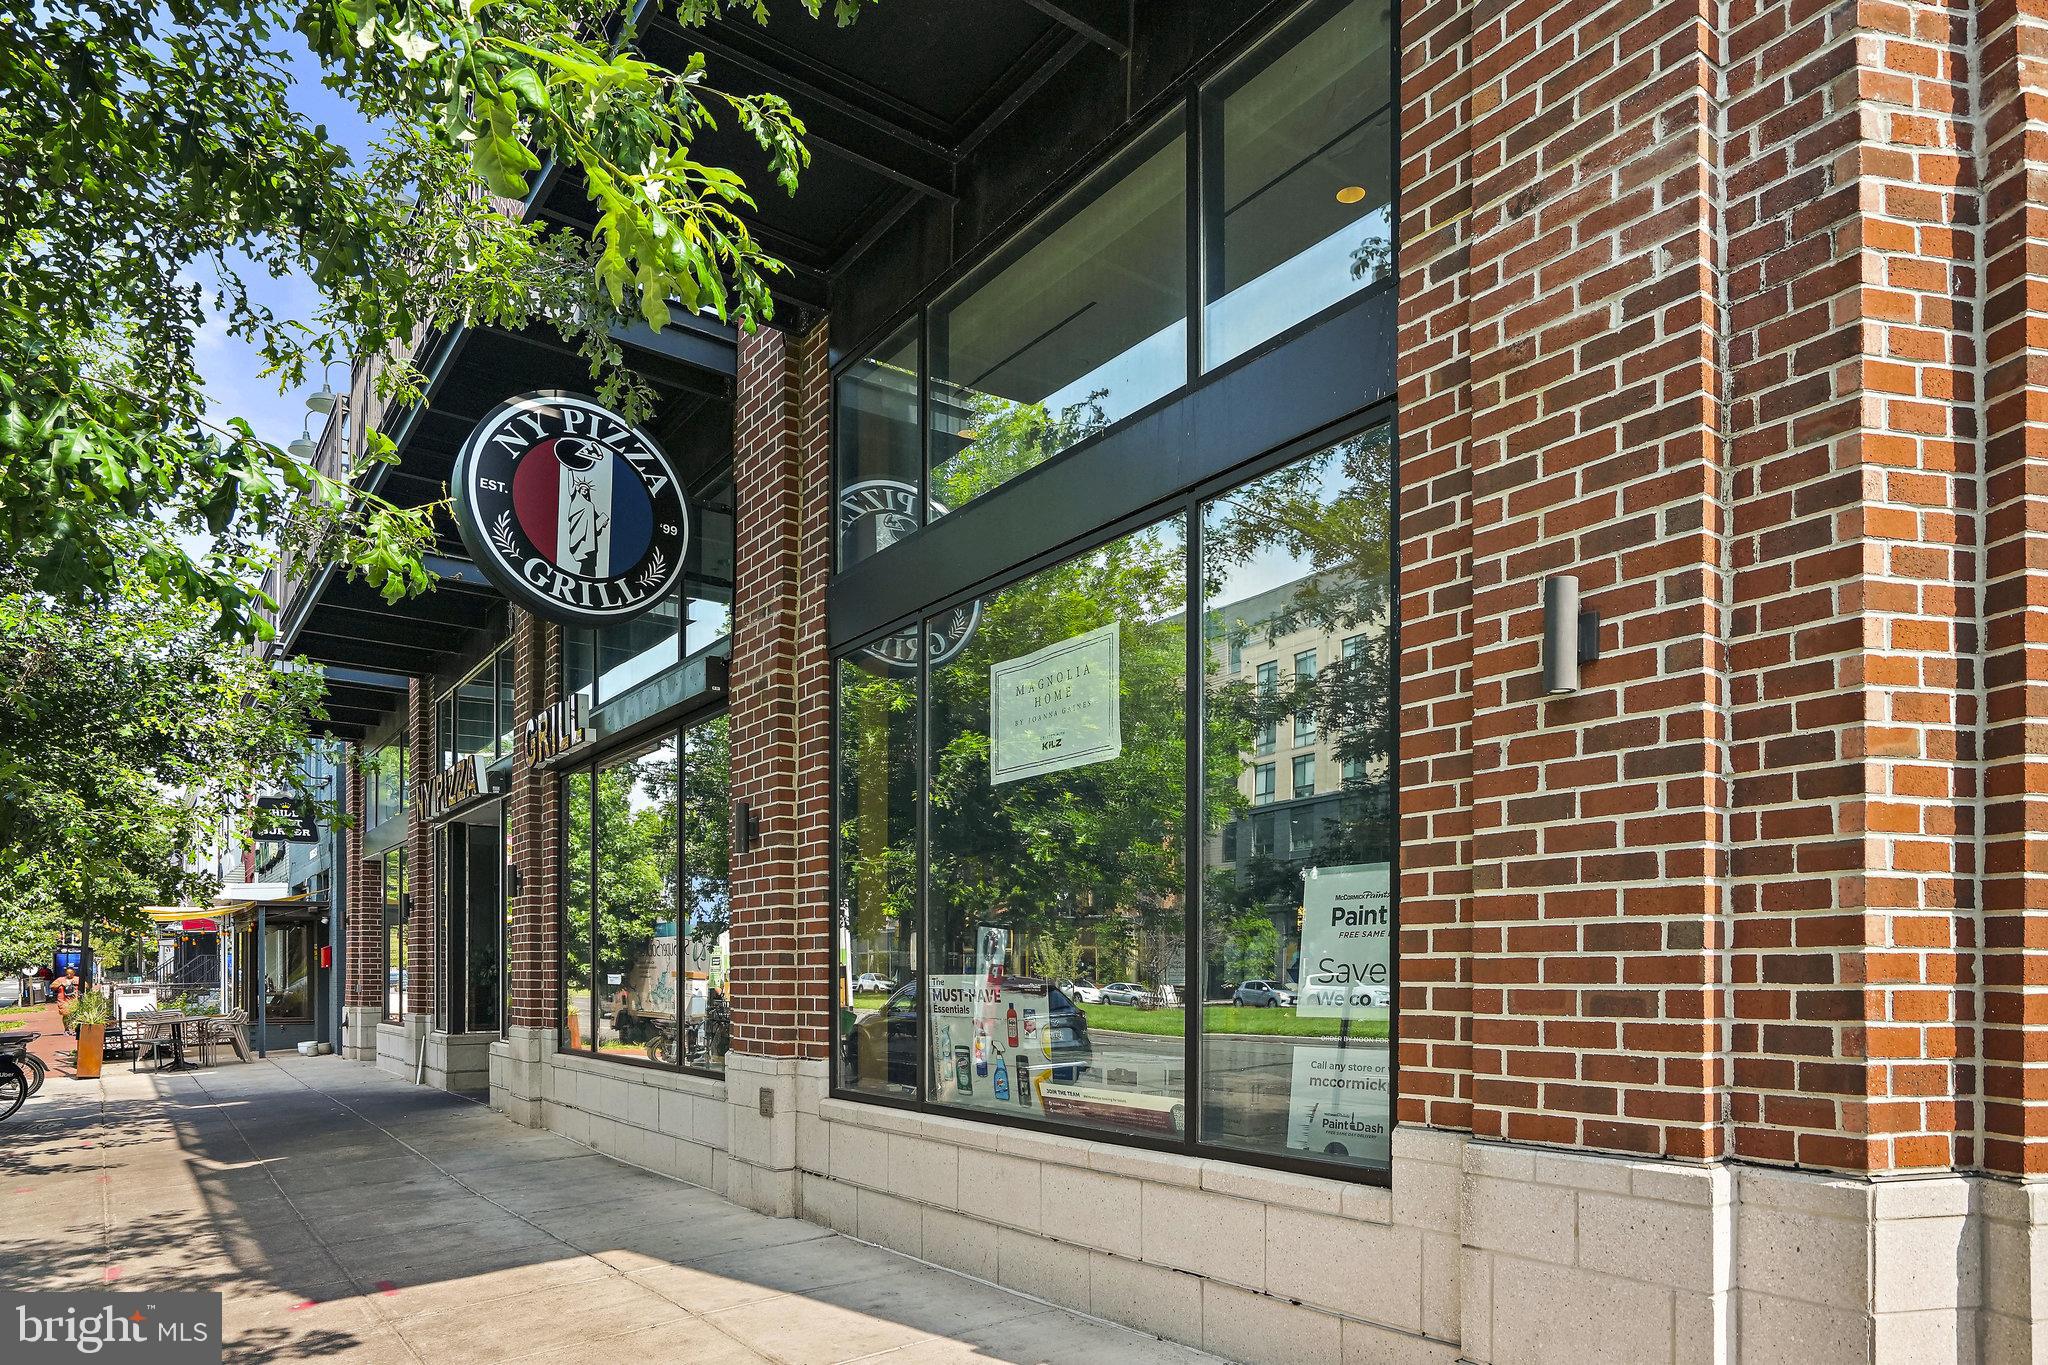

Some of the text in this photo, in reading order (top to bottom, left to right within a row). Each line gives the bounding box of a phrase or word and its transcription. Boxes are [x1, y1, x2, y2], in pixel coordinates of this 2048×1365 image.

[492, 407, 668, 499] NY PIZZA
[479, 477, 509, 494] EST.
[523, 557, 646, 609] GRILL
[1015, 664, 1091, 697] MAGNOLIA
[1034, 686, 1073, 708] HOME
[524, 693, 586, 769] GRILL
[415, 755, 480, 822] NY PIZZA
[1332, 905, 1388, 926] Paint
[1317, 958, 1387, 984] Save
[932, 988, 1002, 1003] MUST-HAVE
[934, 1004, 970, 1014] Essentials
[1311, 1060, 1327, 1069] Call
[1330, 1063, 1345, 1072] any
[1348, 1064, 1372, 1072] store
[1322, 1118, 1384, 1134] Paint Dash
